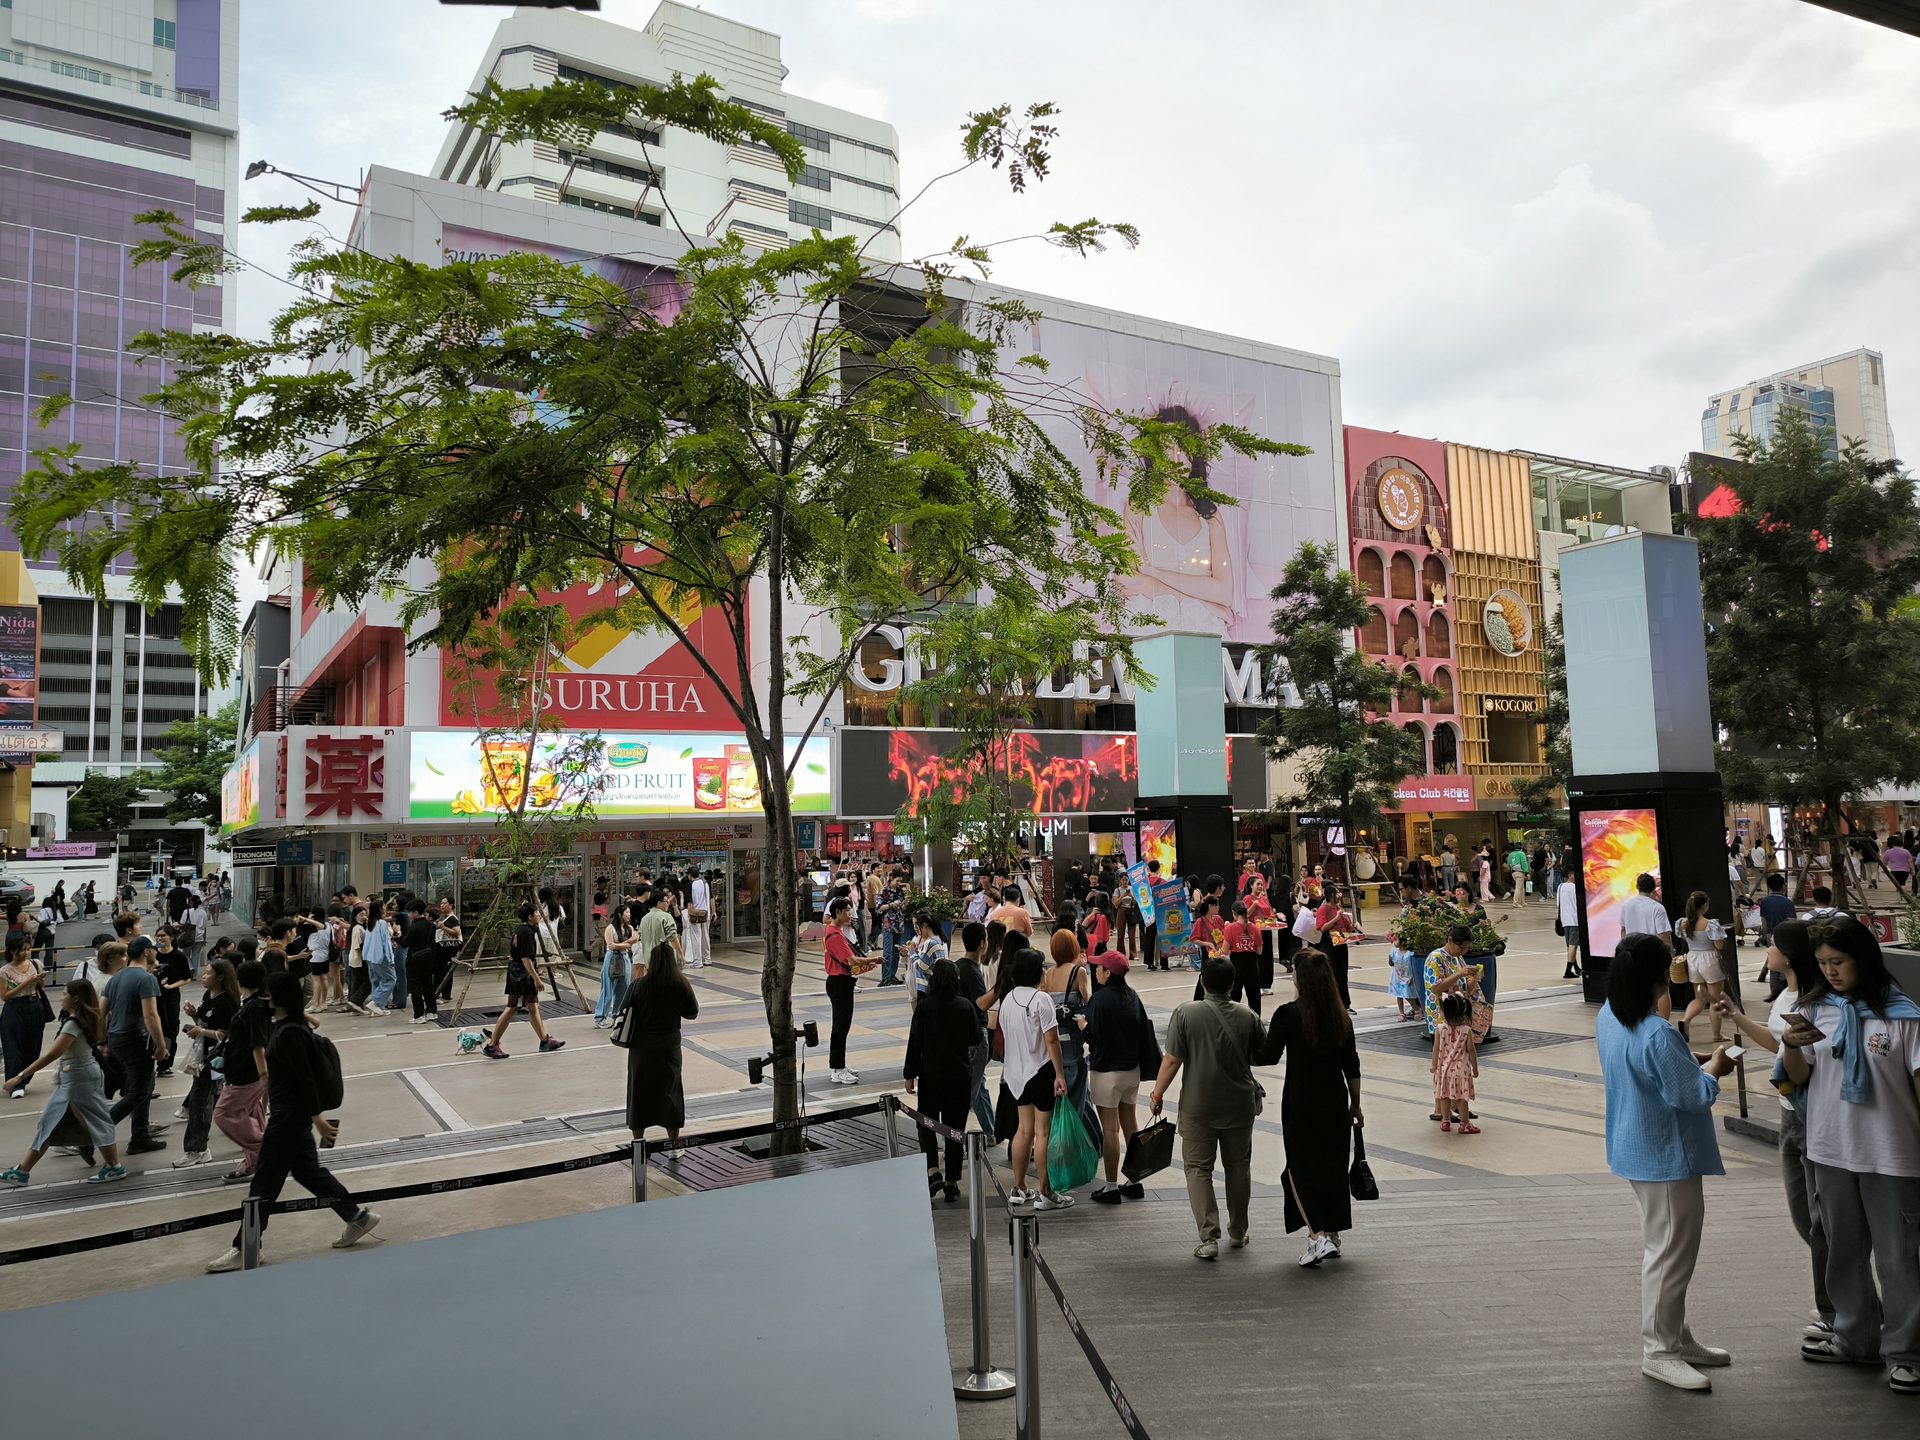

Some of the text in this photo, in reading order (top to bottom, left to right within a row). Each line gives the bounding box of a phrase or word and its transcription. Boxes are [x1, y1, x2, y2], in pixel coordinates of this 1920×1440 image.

[0, 616, 35, 628] Nida
[1494, 699, 1538, 712] KOGORO
[608, 745, 646, 761] Goody
[699, 763, 720, 772] Goody
[634, 773, 687, 789] FRUIT
[1393, 788, 1417, 799] cken
[1419, 788, 1441, 799] Club
[720, 825, 731, 833] VAT
